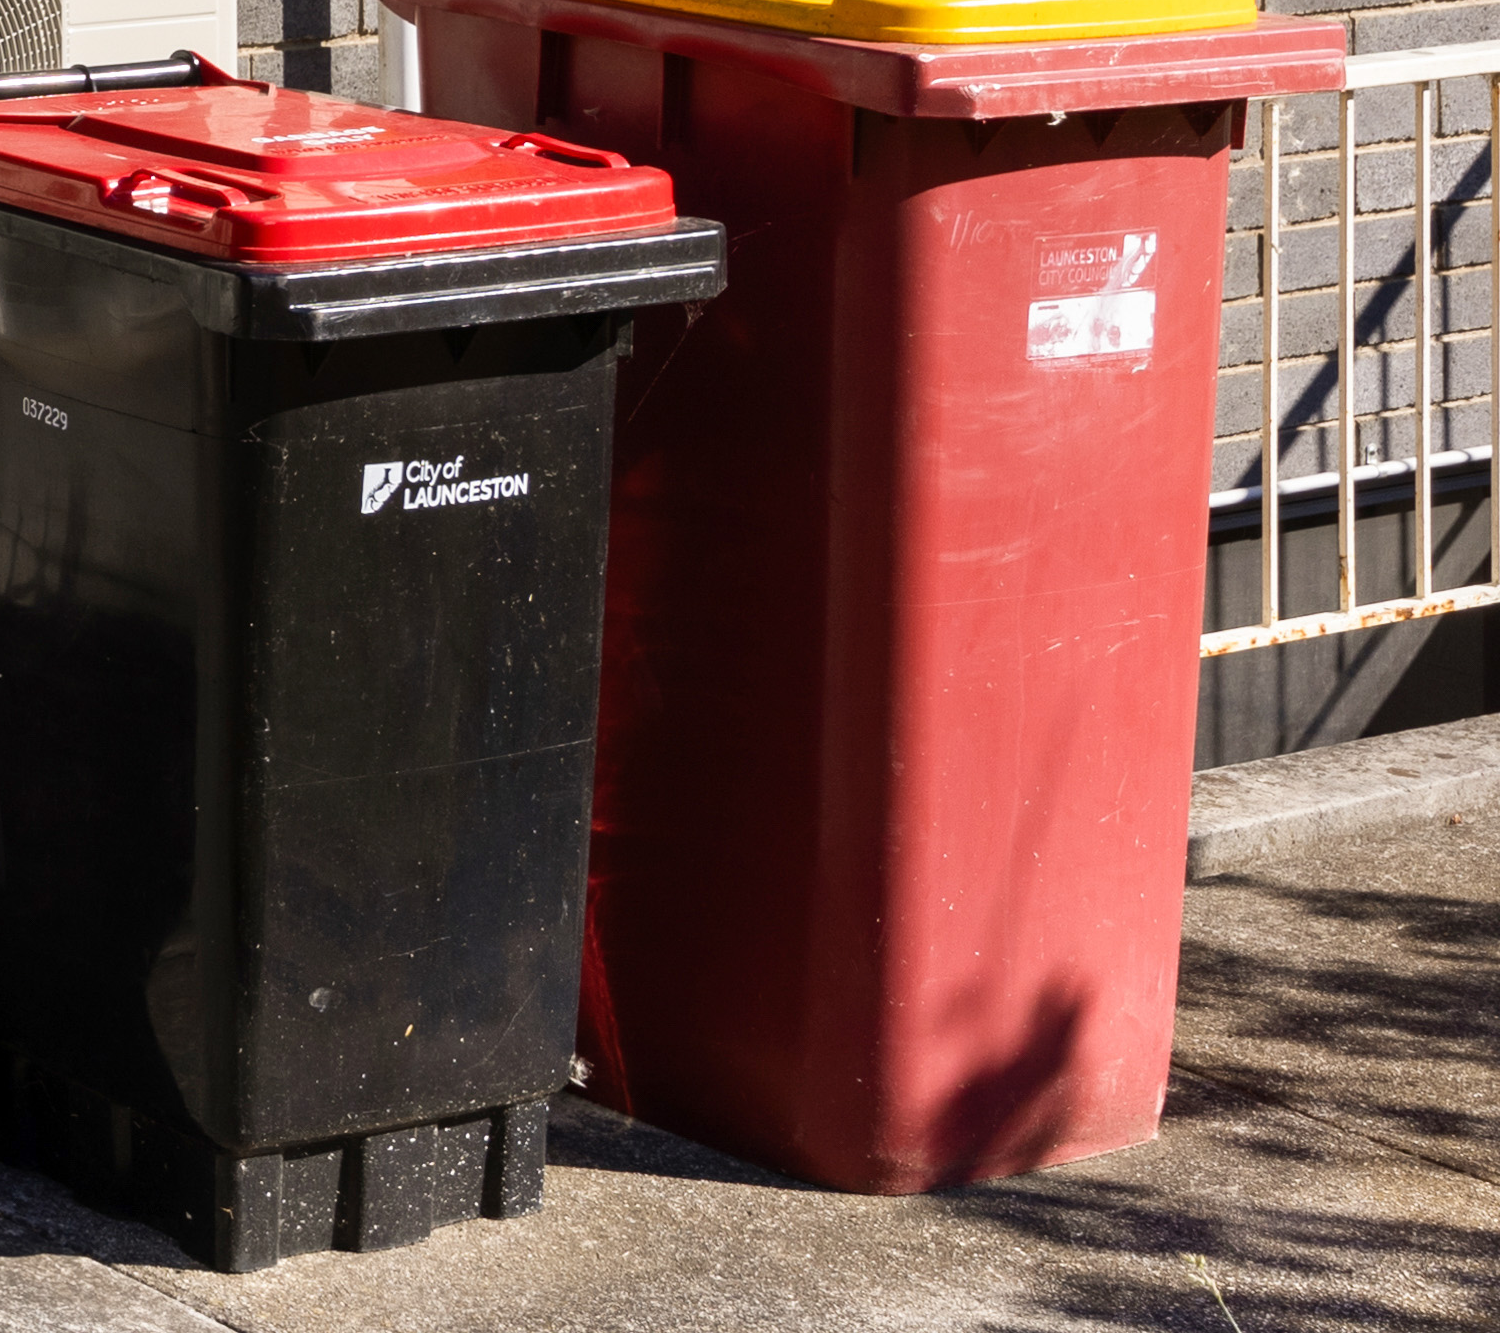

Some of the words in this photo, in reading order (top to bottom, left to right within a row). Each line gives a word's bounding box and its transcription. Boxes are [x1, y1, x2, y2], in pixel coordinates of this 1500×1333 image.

[1039, 246, 1118, 268] LAUNCESTON
[1038, 268, 1063, 286] CITY
[22, 396, 68, 430] 037229
[405, 459, 442, 486] City
[442, 454, 465, 479] of
[403, 472, 529, 510] LAUNCESTON
